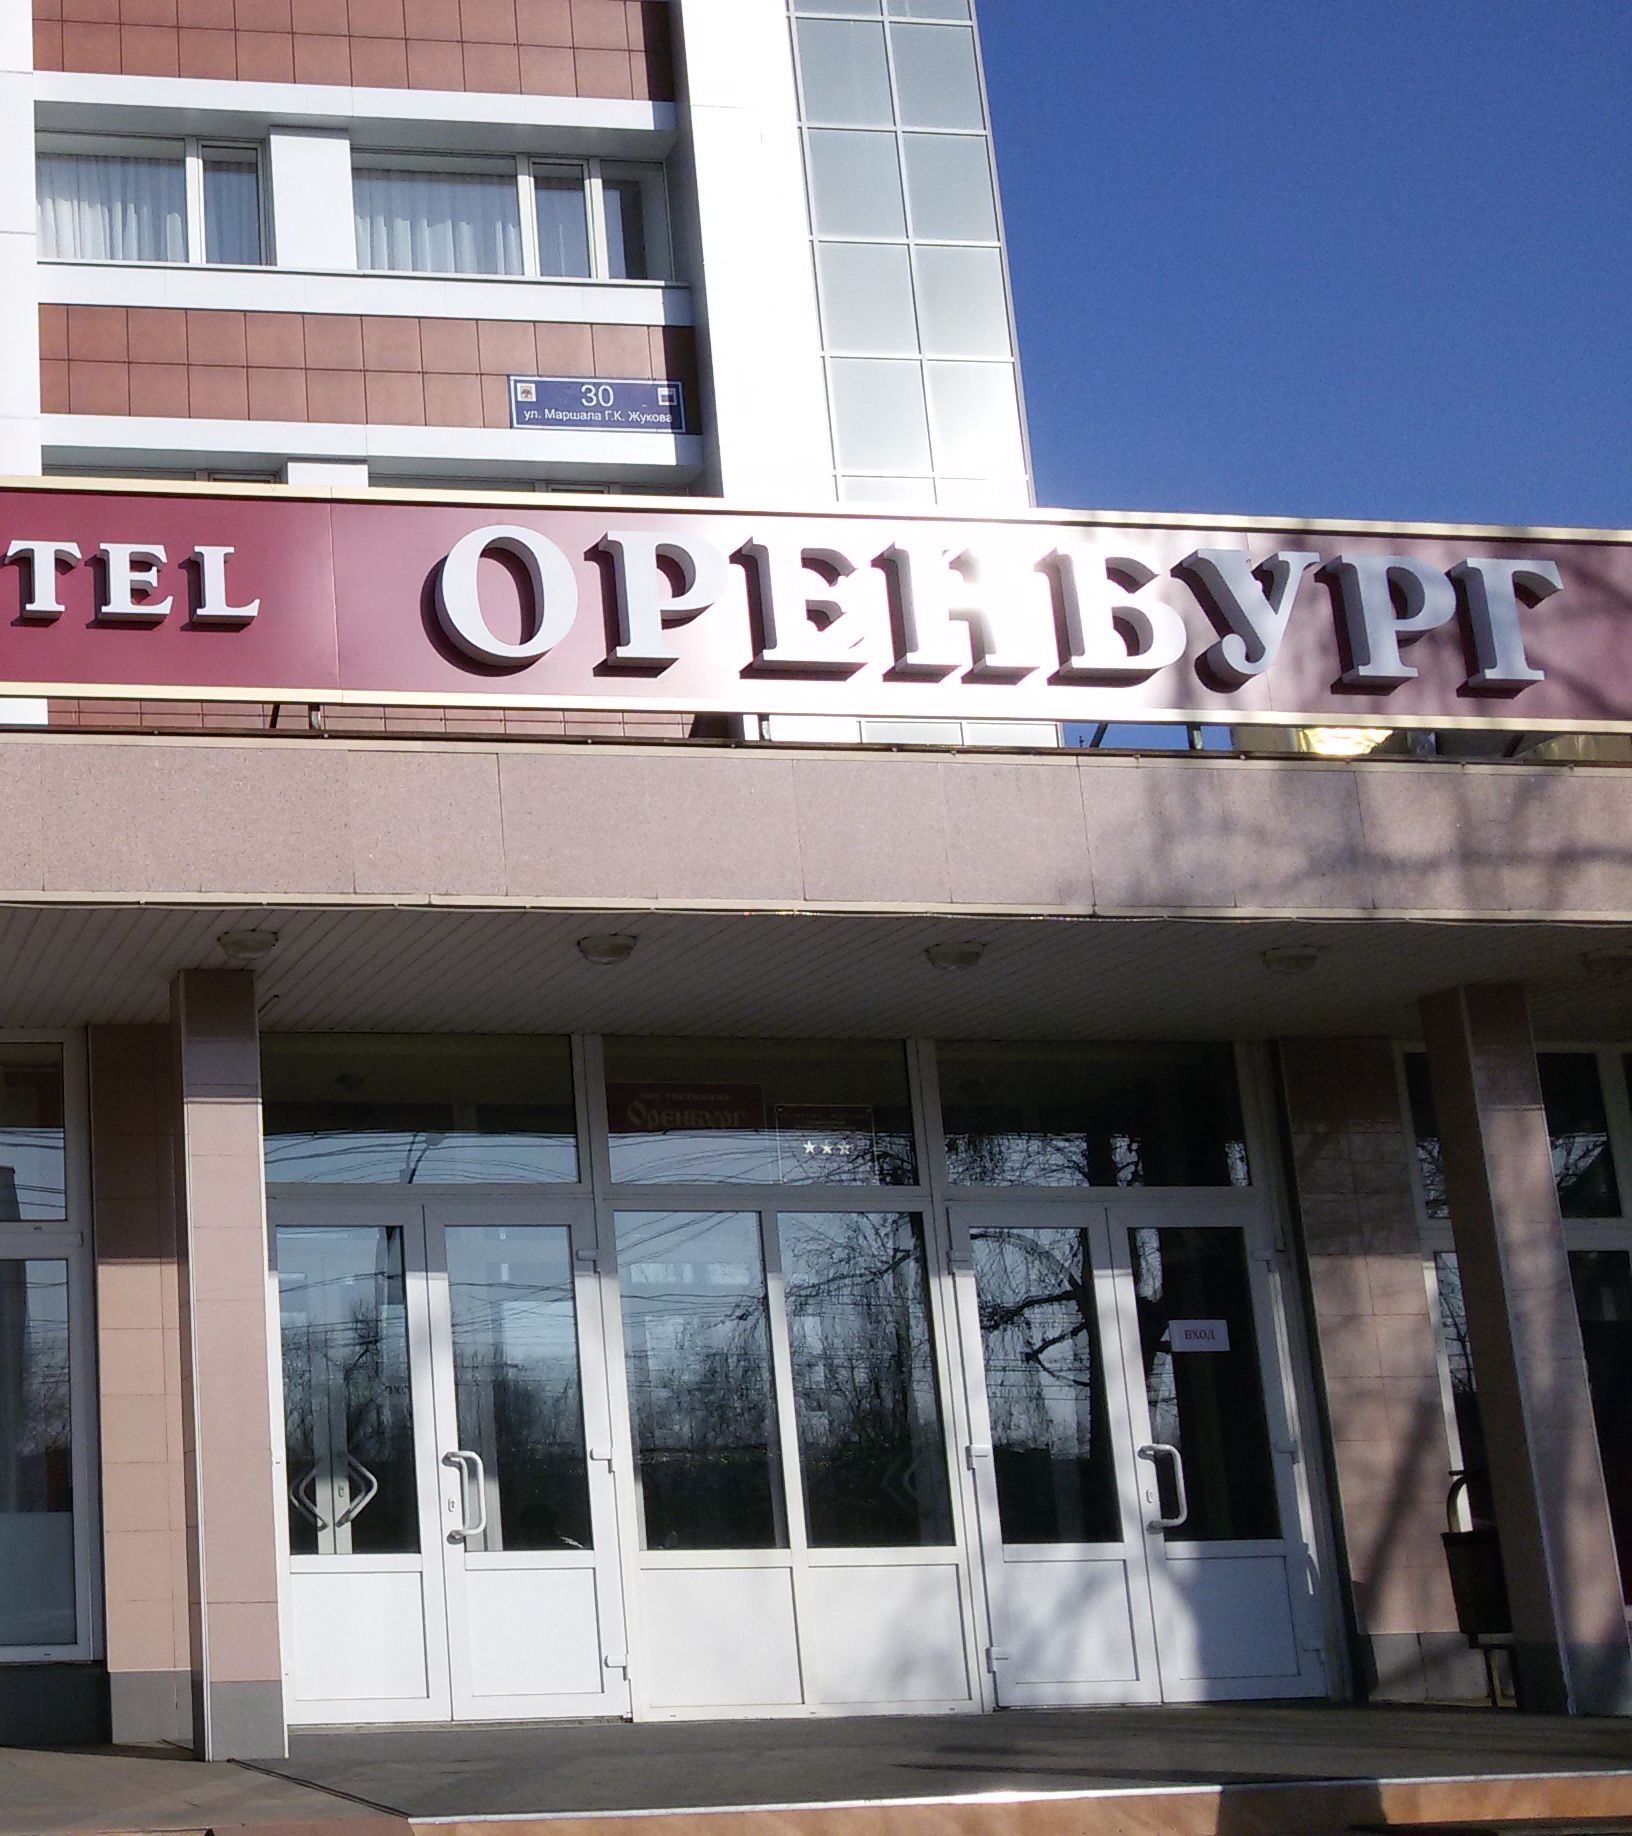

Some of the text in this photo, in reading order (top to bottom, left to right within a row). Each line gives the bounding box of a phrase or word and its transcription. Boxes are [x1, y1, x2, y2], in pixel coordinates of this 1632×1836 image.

[581, 385, 615, 407] 30
[523, 408, 672, 424] ул. Маршала Г.К. Жукова
[435, 523, 1564, 688] ОРЕНБУРГ
